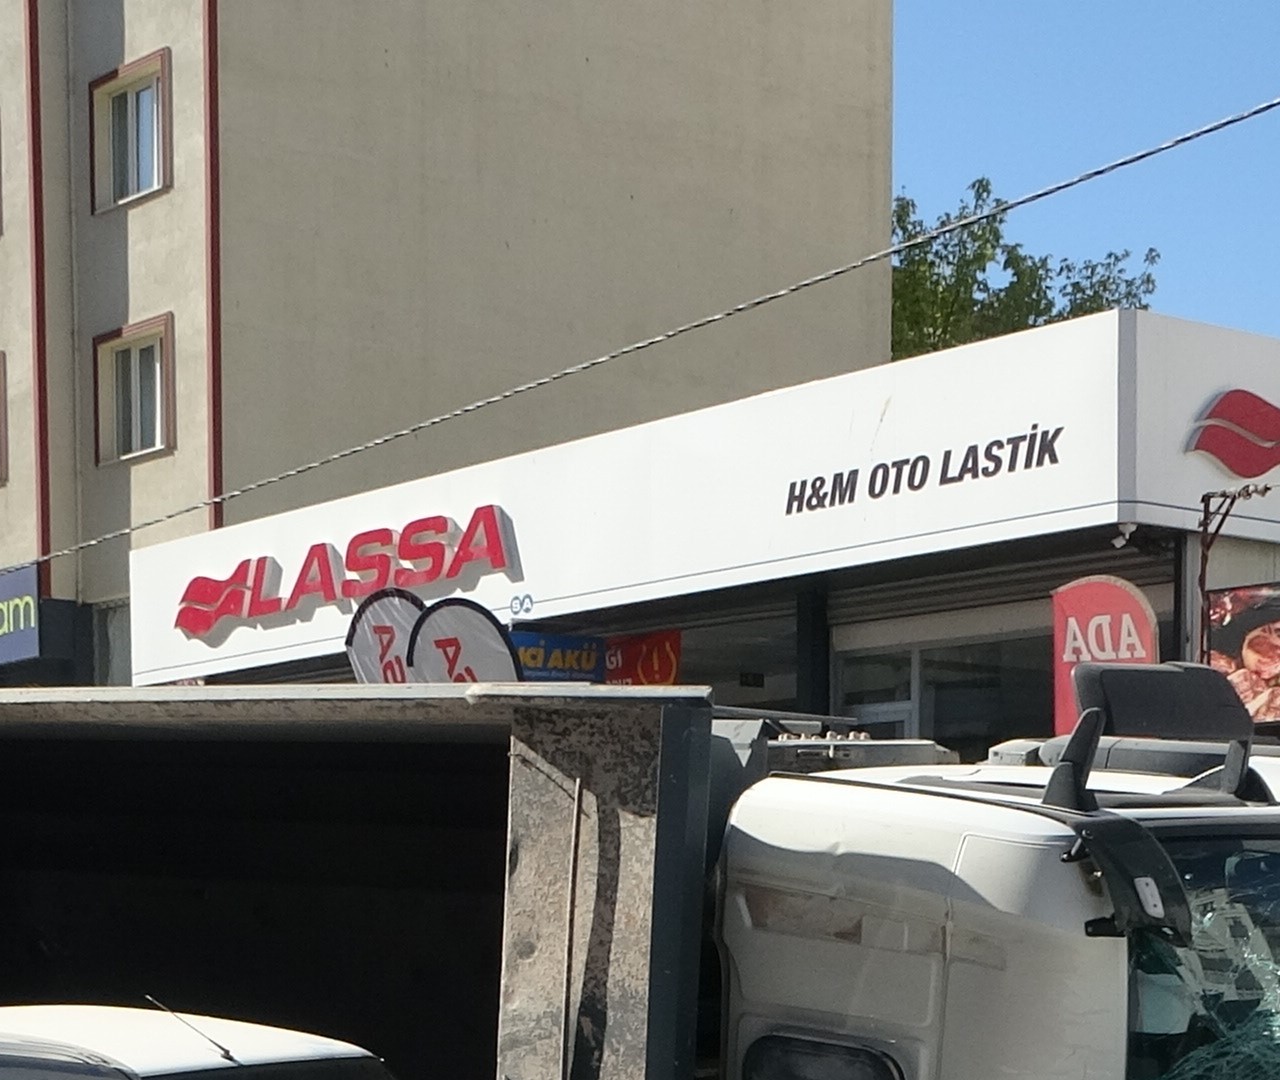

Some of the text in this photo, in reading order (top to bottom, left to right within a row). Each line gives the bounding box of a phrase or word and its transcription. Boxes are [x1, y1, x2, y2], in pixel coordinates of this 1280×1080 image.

[785, 422, 1065, 516] H&M OTO LASTİK
[248, 504, 507, 619] LASSA
